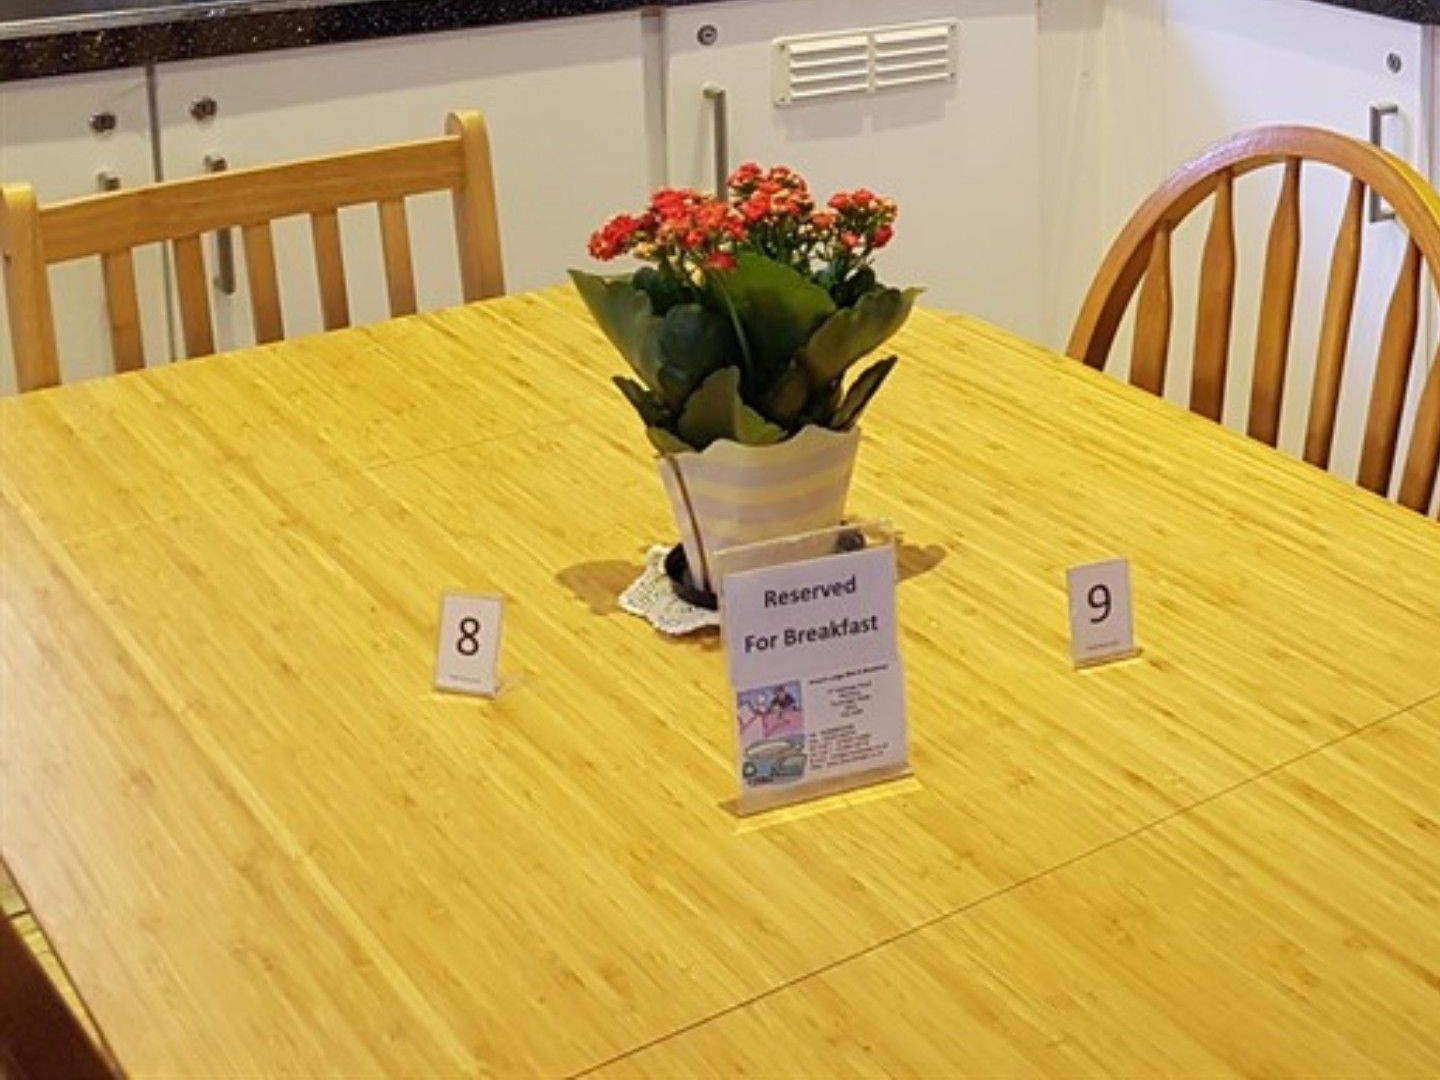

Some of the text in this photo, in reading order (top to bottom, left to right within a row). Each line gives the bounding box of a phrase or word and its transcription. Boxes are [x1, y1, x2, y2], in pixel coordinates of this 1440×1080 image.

[763, 574, 858, 609] Reserved
[1087, 584, 1112, 624] 9
[456, 616, 480, 656] 8
[743, 614, 880, 654] For Breakfast
